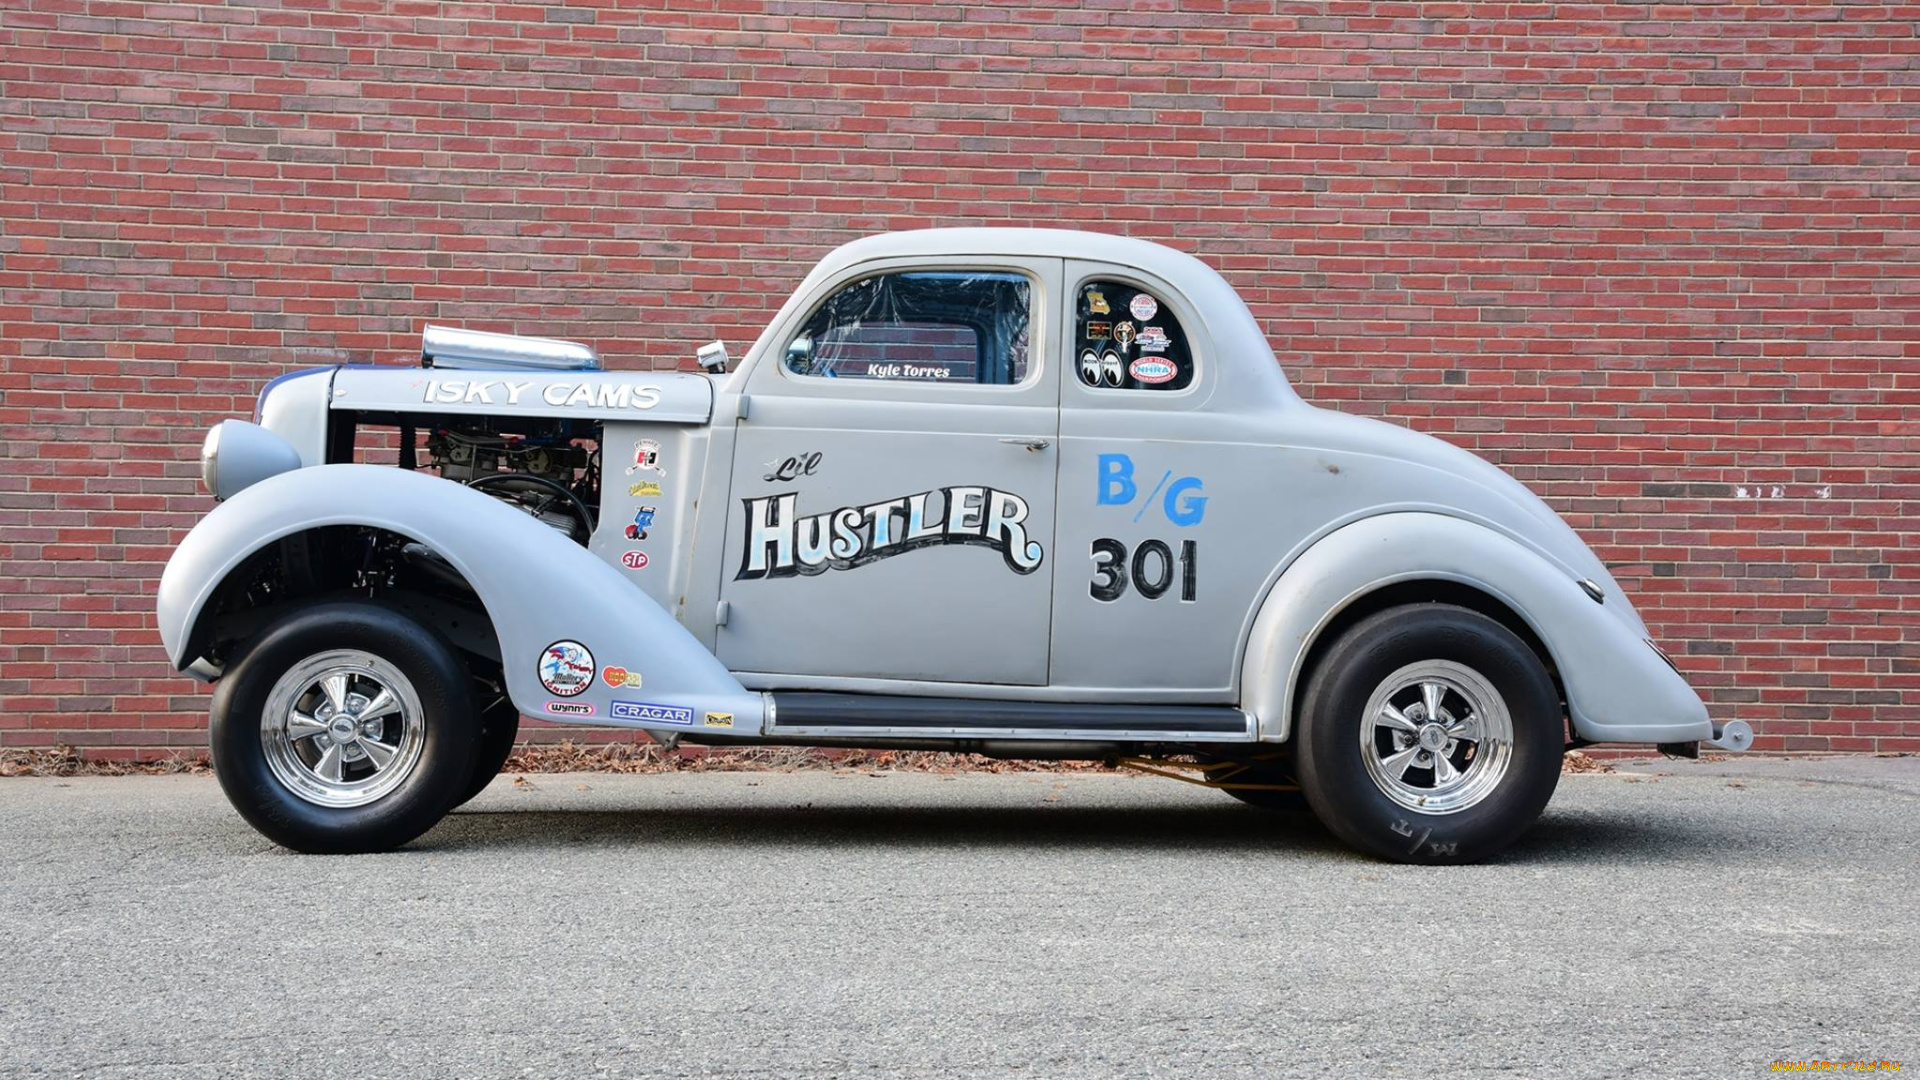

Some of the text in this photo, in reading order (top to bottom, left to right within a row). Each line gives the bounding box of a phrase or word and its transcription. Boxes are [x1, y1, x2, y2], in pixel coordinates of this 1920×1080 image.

[867, 363, 951, 379] Kyle Torres
[423, 380, 662, 410] ISKY CAMS
[1096, 452, 1210, 527] B/G
[624, 552, 646, 567] STP
[1088, 537, 1197, 604] 301
[544, 678, 587, 694] IGNITION
[615, 705, 687, 720] CRAGAR
